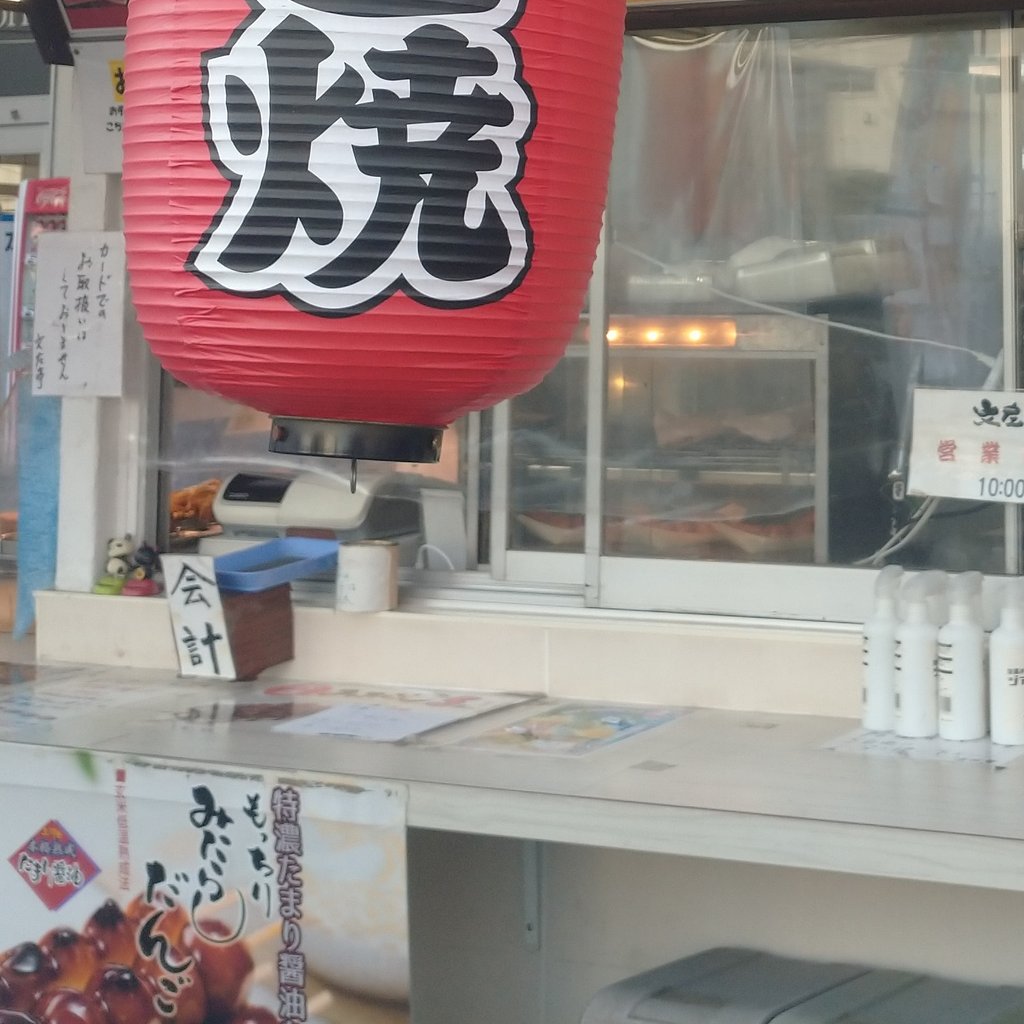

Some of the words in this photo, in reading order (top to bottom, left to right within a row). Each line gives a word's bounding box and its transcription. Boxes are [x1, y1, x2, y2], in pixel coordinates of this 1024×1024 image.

[170, 561, 224, 675] 会計
[189, 784, 248, 943] みたらし
[243, 793, 274, 918] もっちり
[137, 860, 194, 1017] だんご
